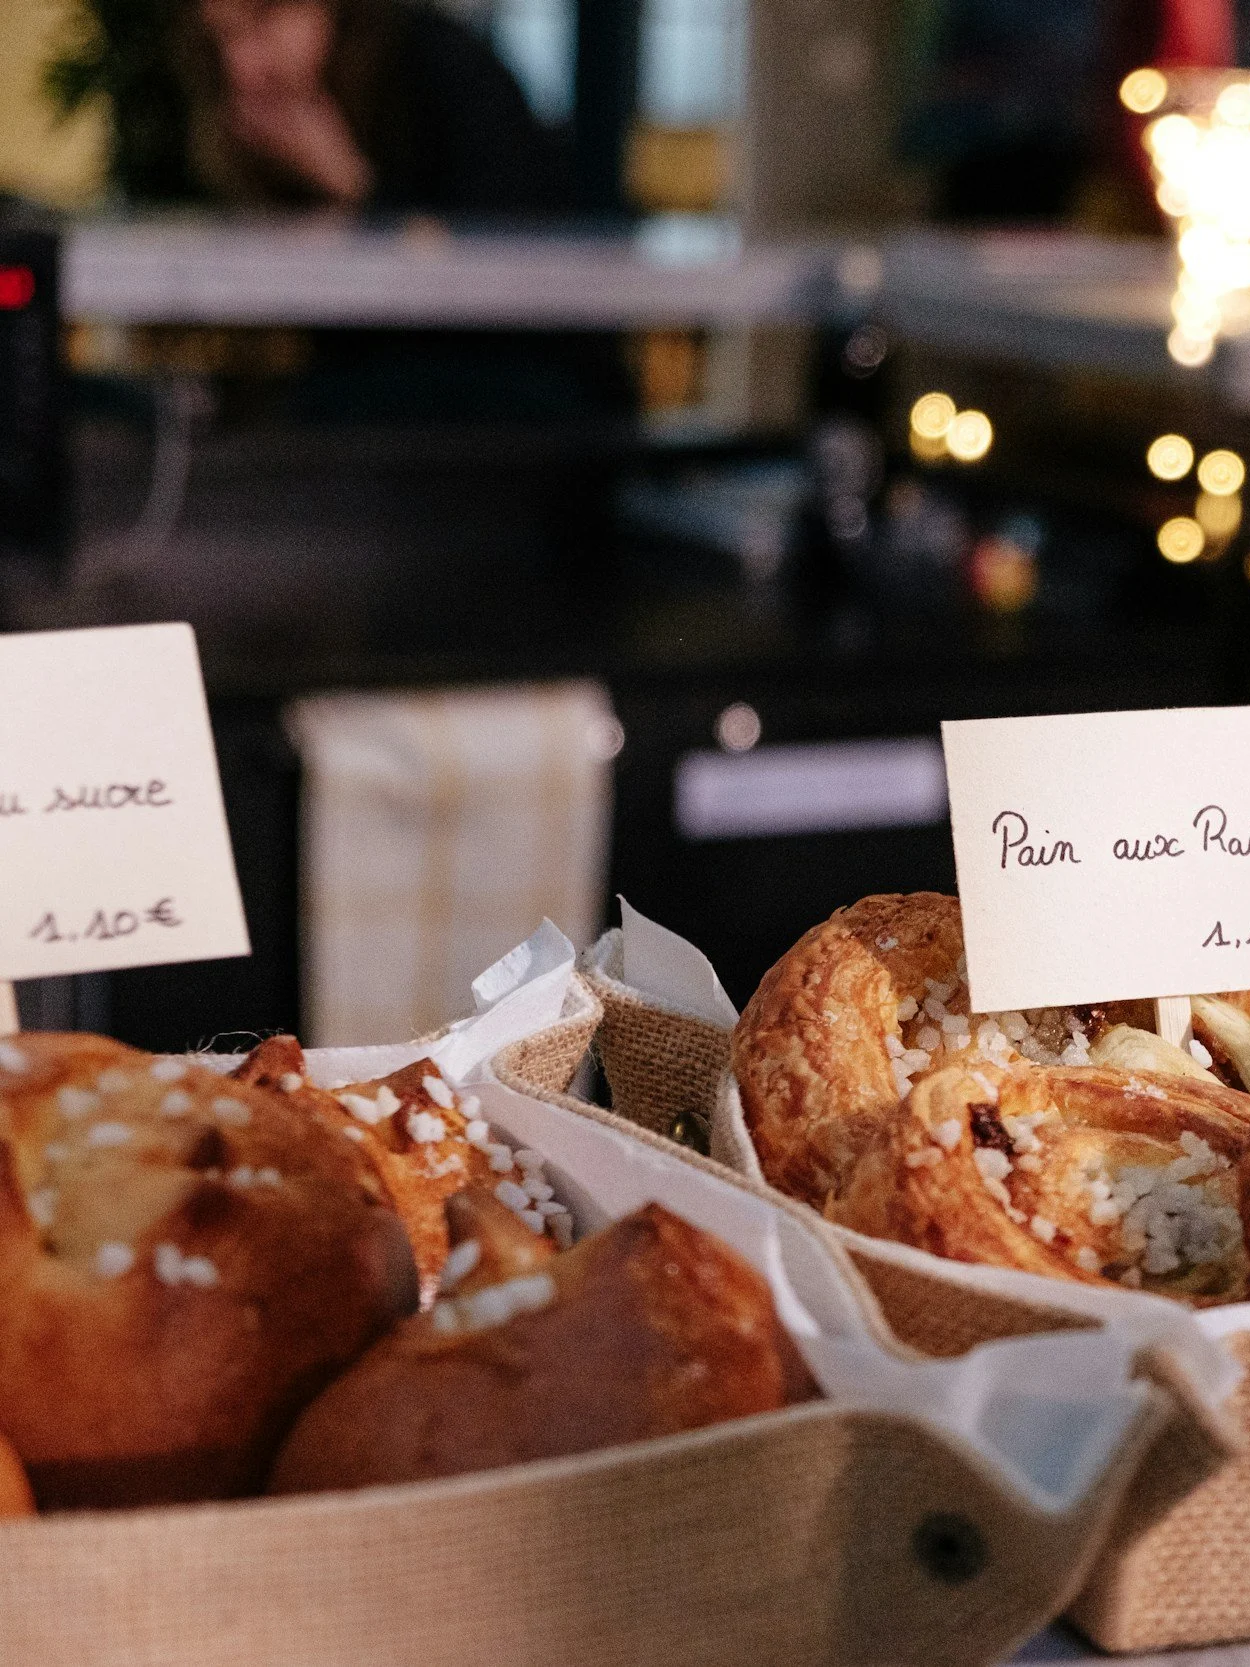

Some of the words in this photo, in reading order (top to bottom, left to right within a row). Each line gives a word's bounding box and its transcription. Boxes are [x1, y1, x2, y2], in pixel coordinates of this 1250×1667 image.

[45, 778, 173, 813] sucre
[991, 810, 1082, 870] Pain
[1112, 833, 1186, 862] aux
